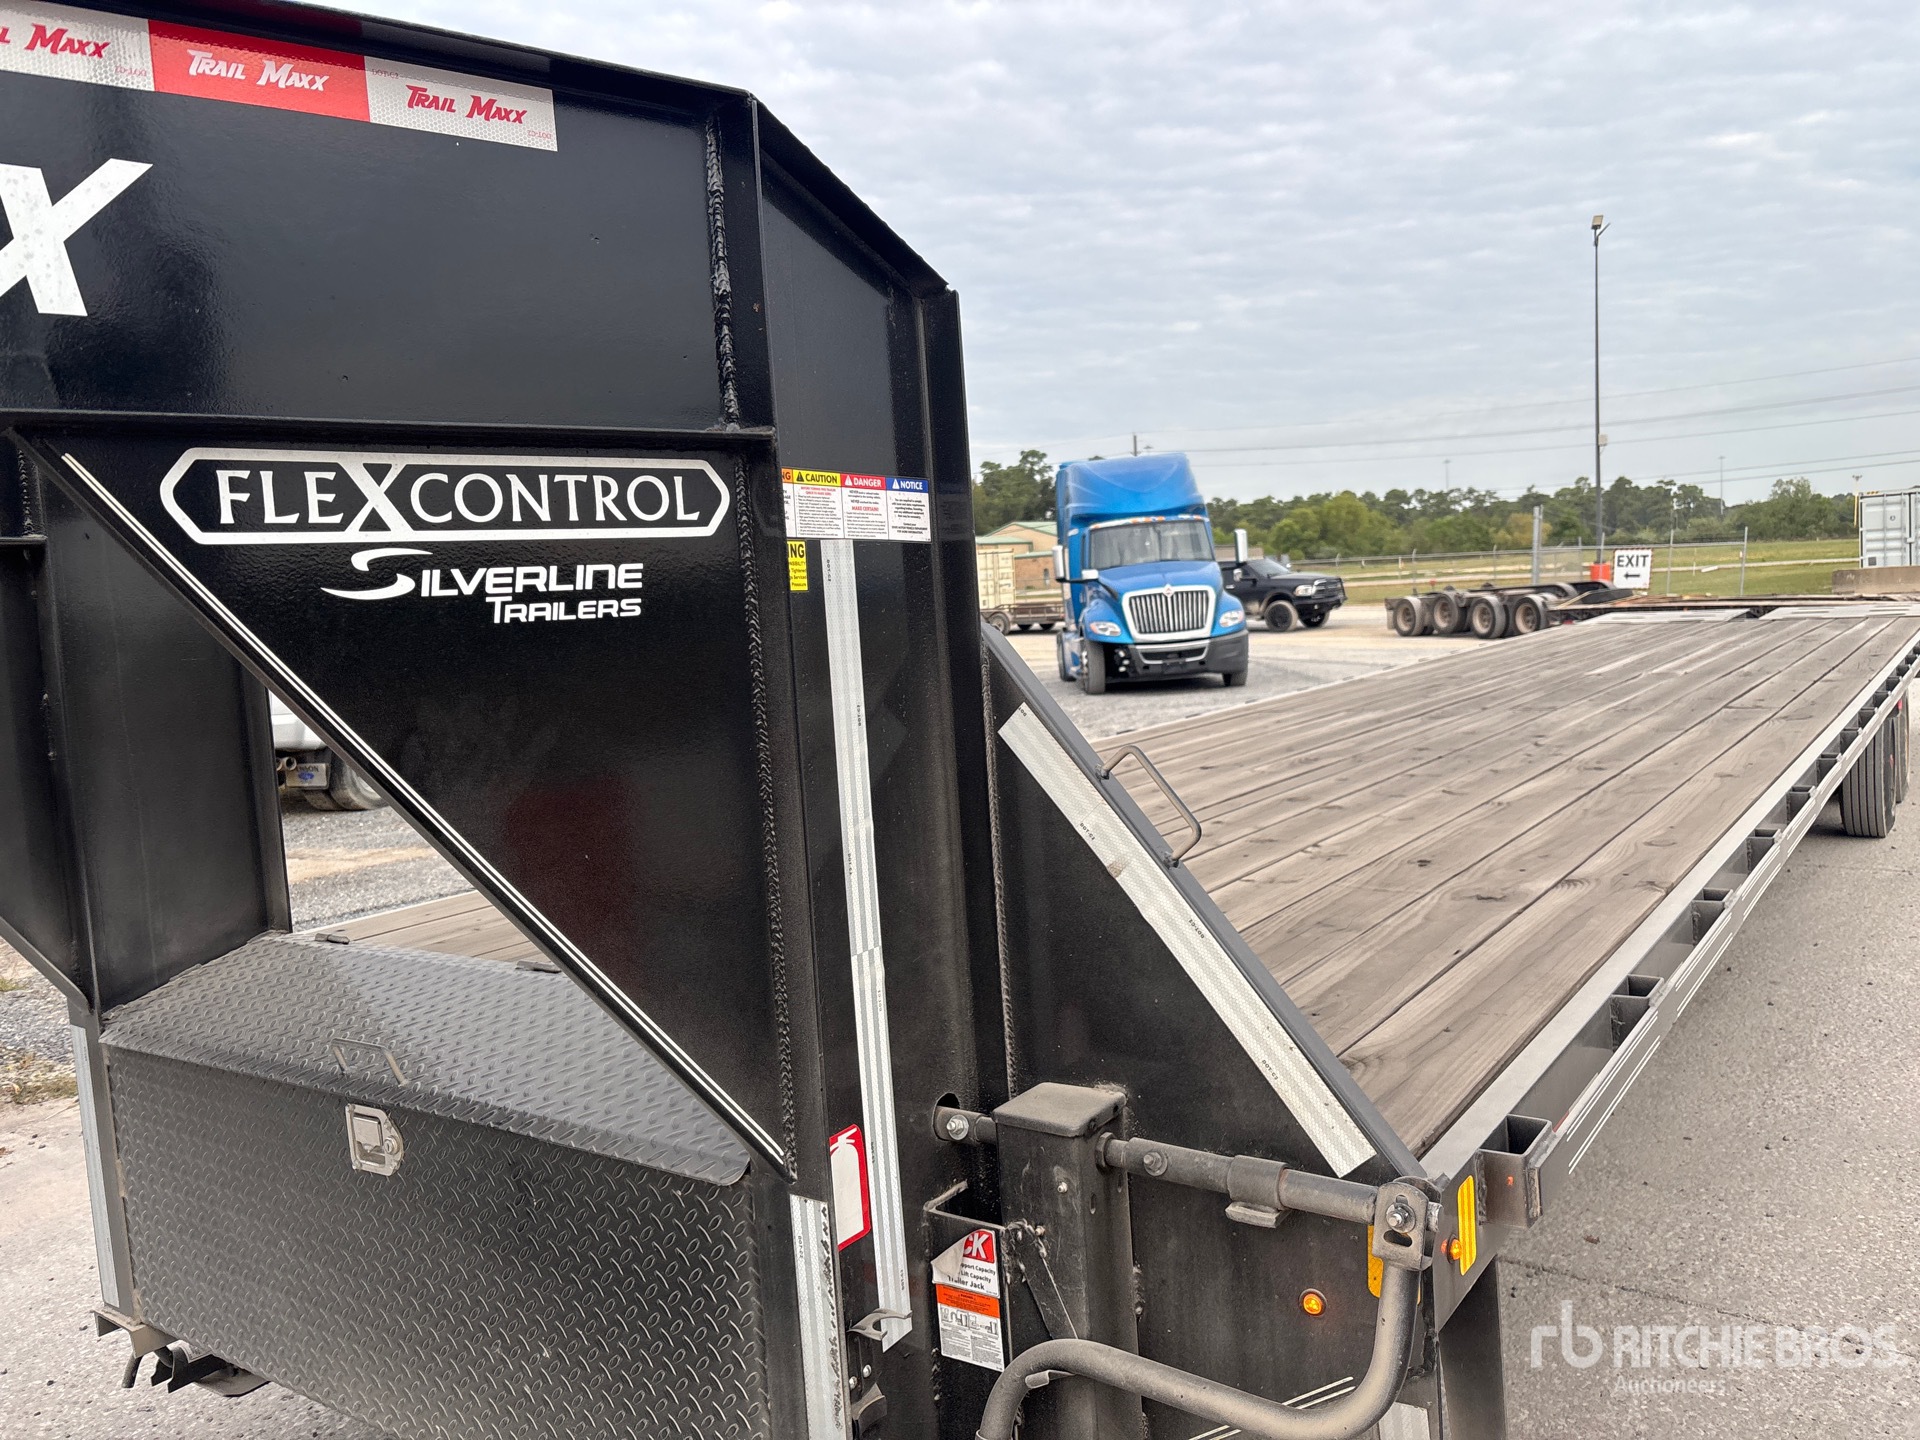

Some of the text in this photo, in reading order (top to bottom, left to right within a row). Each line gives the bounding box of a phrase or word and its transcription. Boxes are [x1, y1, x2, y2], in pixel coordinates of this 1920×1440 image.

[805, 473, 838, 484] CAUTION
[853, 478, 882, 488] DANGER
[900, 481, 923, 491] NOTICE
[215, 462, 701, 532] FLEXCONTROL
[1617, 554, 1649, 568] EXIT
[320, 547, 643, 600] SILVERLINE
[970, 1272, 991, 1283] Capacity
[970, 1281, 985, 1290] Jack
